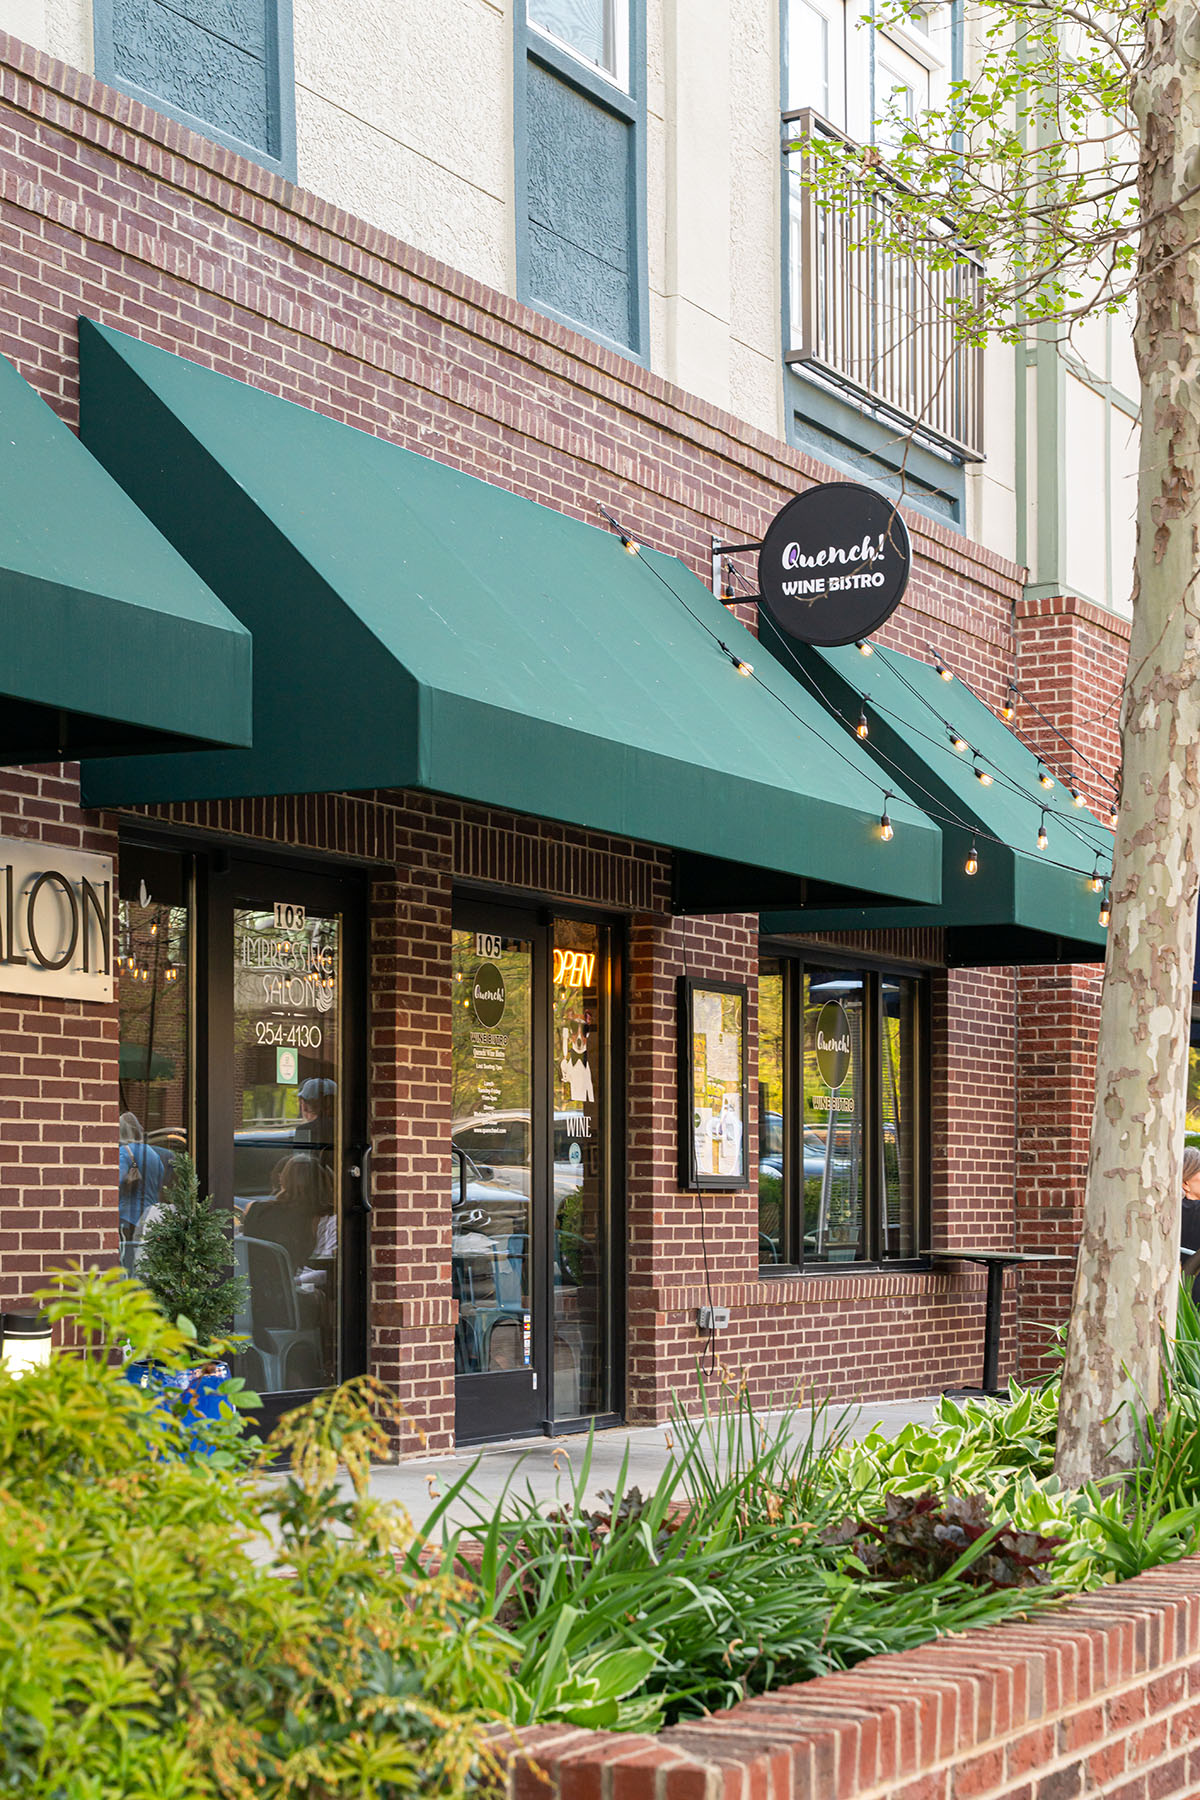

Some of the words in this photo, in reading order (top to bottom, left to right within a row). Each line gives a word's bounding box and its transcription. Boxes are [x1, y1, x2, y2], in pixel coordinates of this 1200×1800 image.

[782, 533, 885, 570] Quench!
[782, 578, 826, 595] WINE
[828, 572, 885, 591] BISTRO
[0, 865, 110, 976] LON
[276, 905, 304, 929] 103
[242, 935, 333, 974] IMPRESSING
[478, 935, 500, 957] 105
[553, 949, 595, 987] OPEN
[263, 974, 316, 1006] SALON
[475, 984, 505, 1002] Quench!
[255, 1021, 322, 1048] 254-4130
[817, 1030, 850, 1053] Quench!
[566, 1116, 592, 1138] WINE
